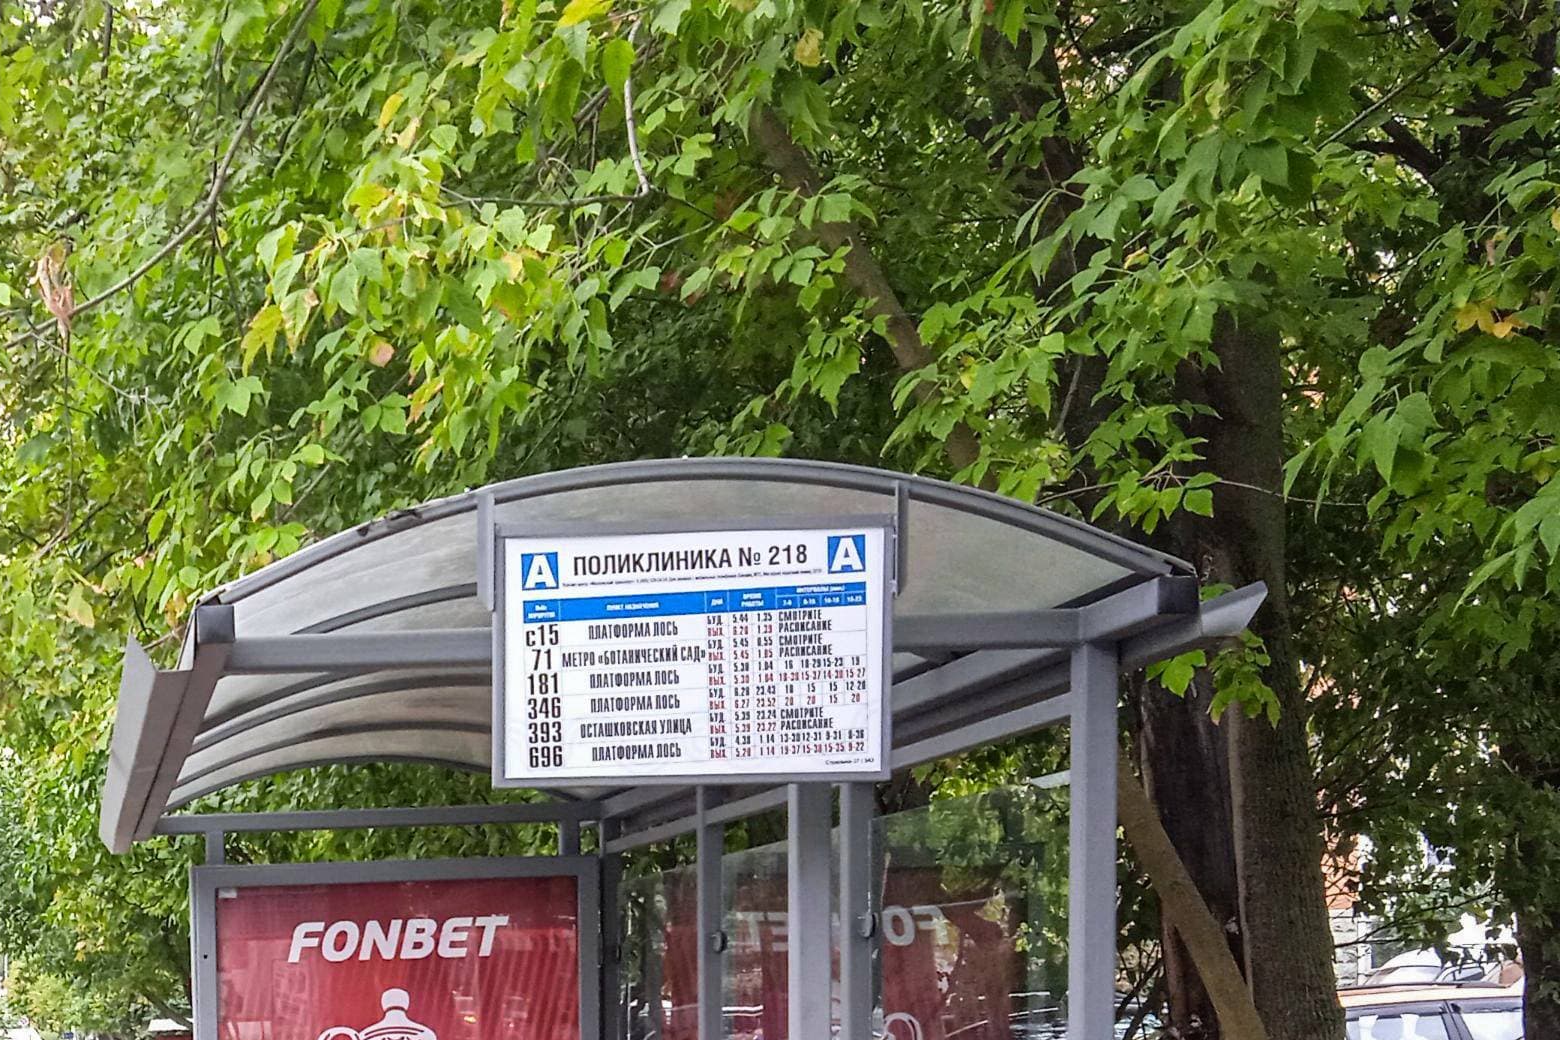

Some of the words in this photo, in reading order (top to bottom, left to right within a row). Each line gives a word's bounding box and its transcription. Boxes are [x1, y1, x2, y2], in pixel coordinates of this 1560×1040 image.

[574, 548, 732, 576] ПОЛИКЛИНИКА
[739, 547, 761, 567] №
[768, 544, 807, 566] 218
[778, 609, 822, 621] СМОТРИТЕ
[525, 624, 559, 647] с15
[588, 622, 651, 640] ПЛАТФОРМА
[652, 621, 679, 637] ЛОСЬ
[778, 619, 832, 633] РАСПИСАНИЕ
[733, 637, 749, 648] 5.45
[778, 633, 823, 646] СМОТРИТЕ
[531, 648, 551, 671] 71
[562, 651, 596, 668] МЕТРО
[598, 645, 678, 666] «БОТАНИЧЕСКИЙ
[680, 645, 706, 663] САД»
[779, 644, 833, 658] РАСПИСАНИЕ
[823, 657, 843, 667] 15-23
[527, 672, 559, 695] 181
[589, 671, 652, 689] ПЛАТФОРМА
[654, 669, 680, 686] ЛОСЬ
[807, 683, 816, 693] 15
[829, 682, 838, 692] 15
[527, 697, 561, 720] 346
[590, 696, 653, 713] ПЛАТФОРМА
[655, 694, 680, 710] ЛОСЬ
[829, 694, 838, 704] 15
[780, 707, 823, 720] СМОТРИТЕ
[528, 721, 562, 744] 393
[580, 720, 657, 739] ОСТАШКОВСКАЯ
[659, 718, 692, 736] УЛИЦА
[780, 717, 834, 731] РАСПИСАНИЕ
[529, 745, 563, 769] 696
[592, 744, 654, 762] ПЛАТФОРМА
[656, 743, 682, 759] ЛОСЬ
[287, 915, 509, 963] FONBET
